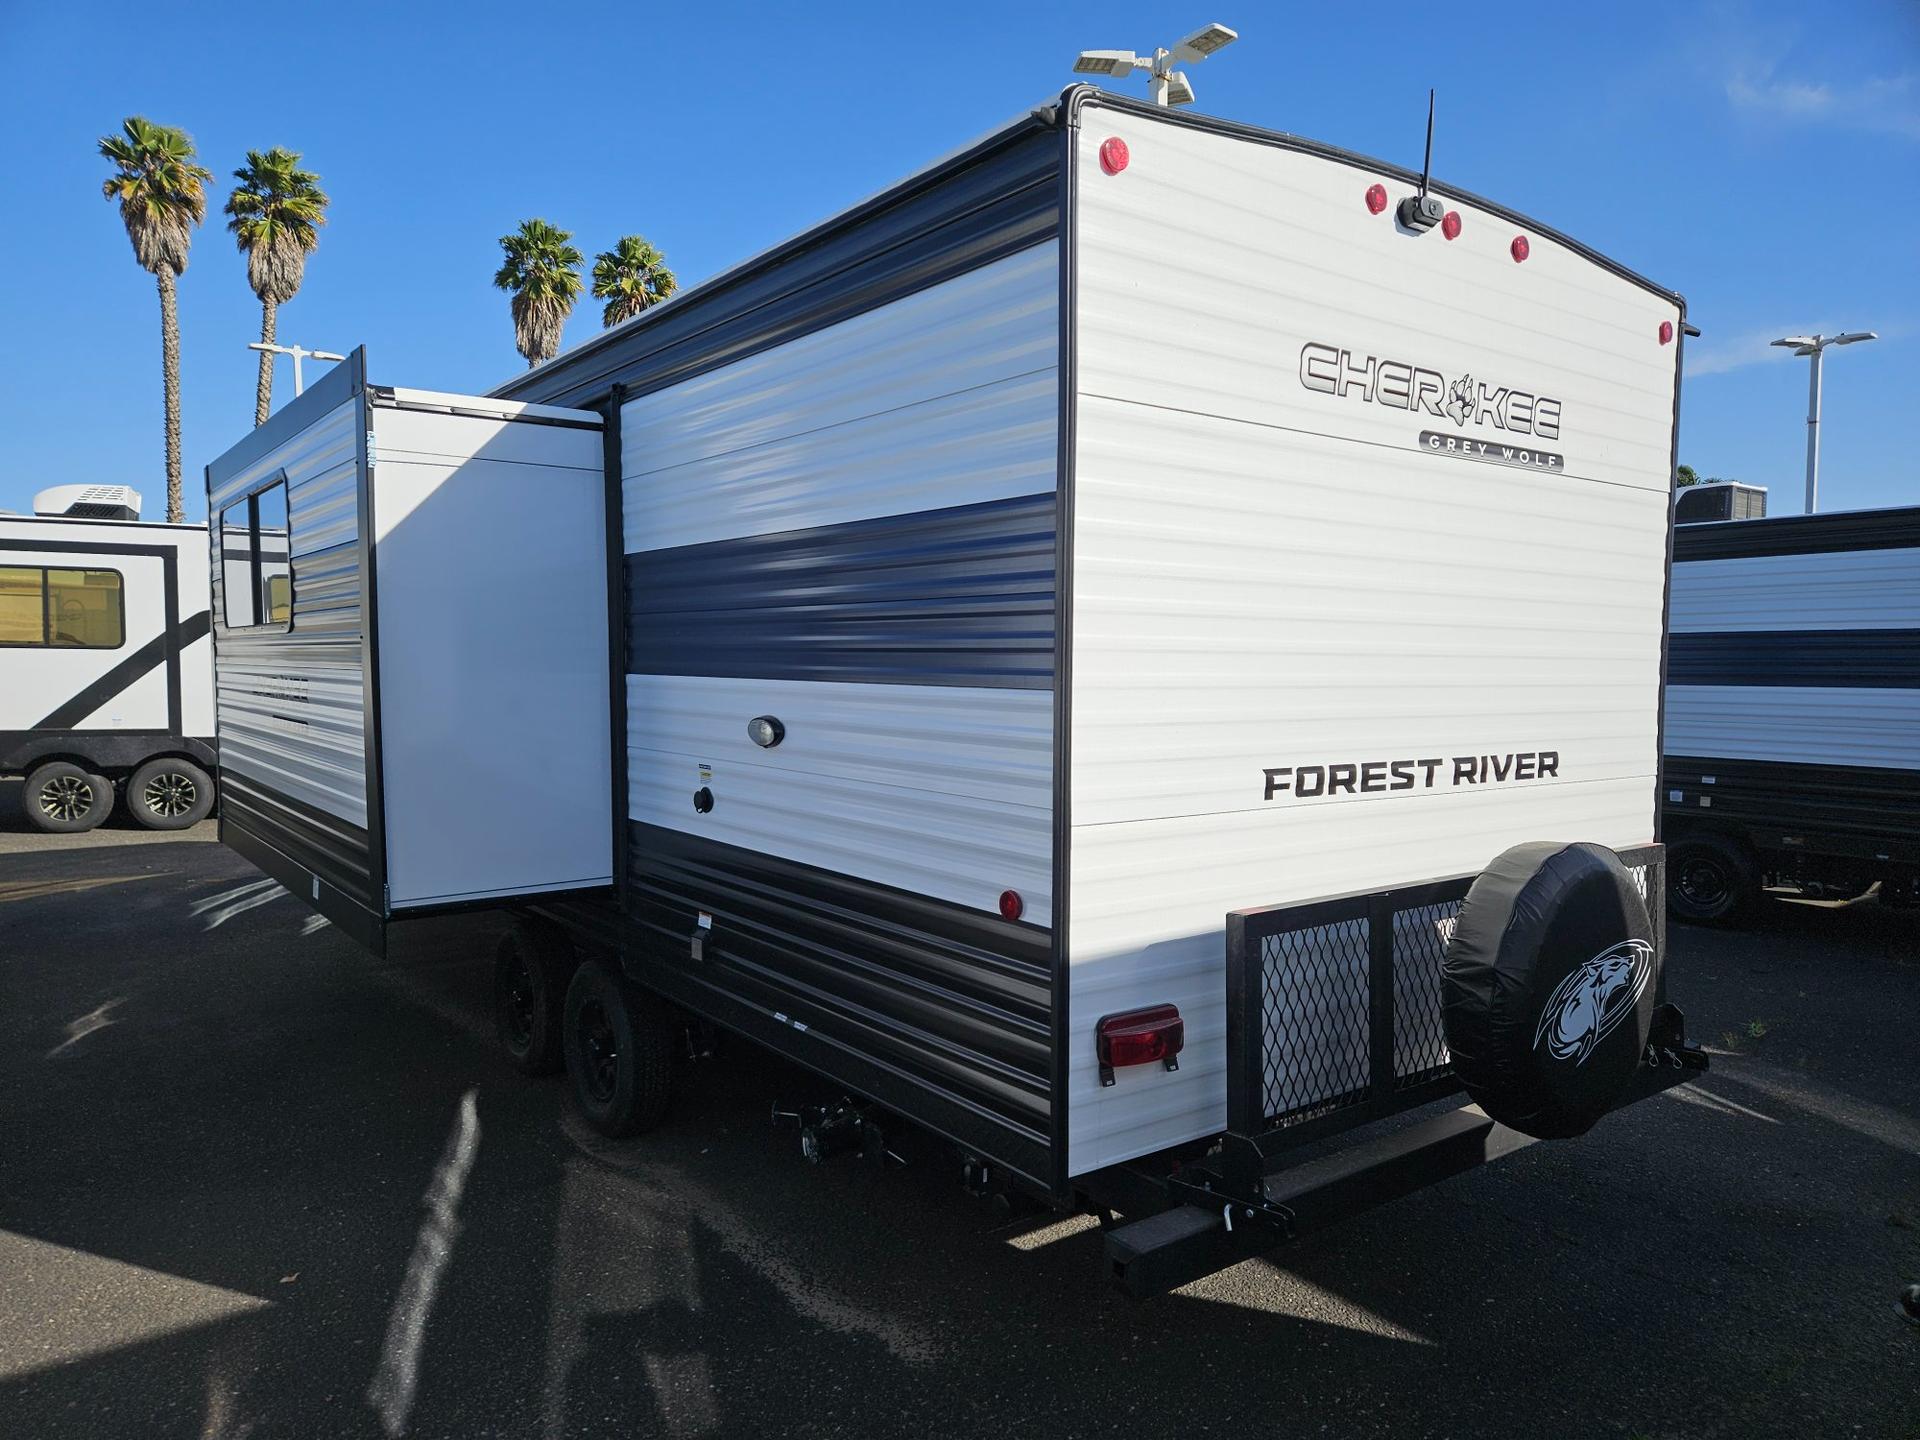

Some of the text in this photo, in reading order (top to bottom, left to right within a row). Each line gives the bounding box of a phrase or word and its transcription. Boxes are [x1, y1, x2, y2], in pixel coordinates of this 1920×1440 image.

[1429, 434, 1557, 469] GREY WOLF
[1262, 751, 1559, 801] FOREST RIVER
